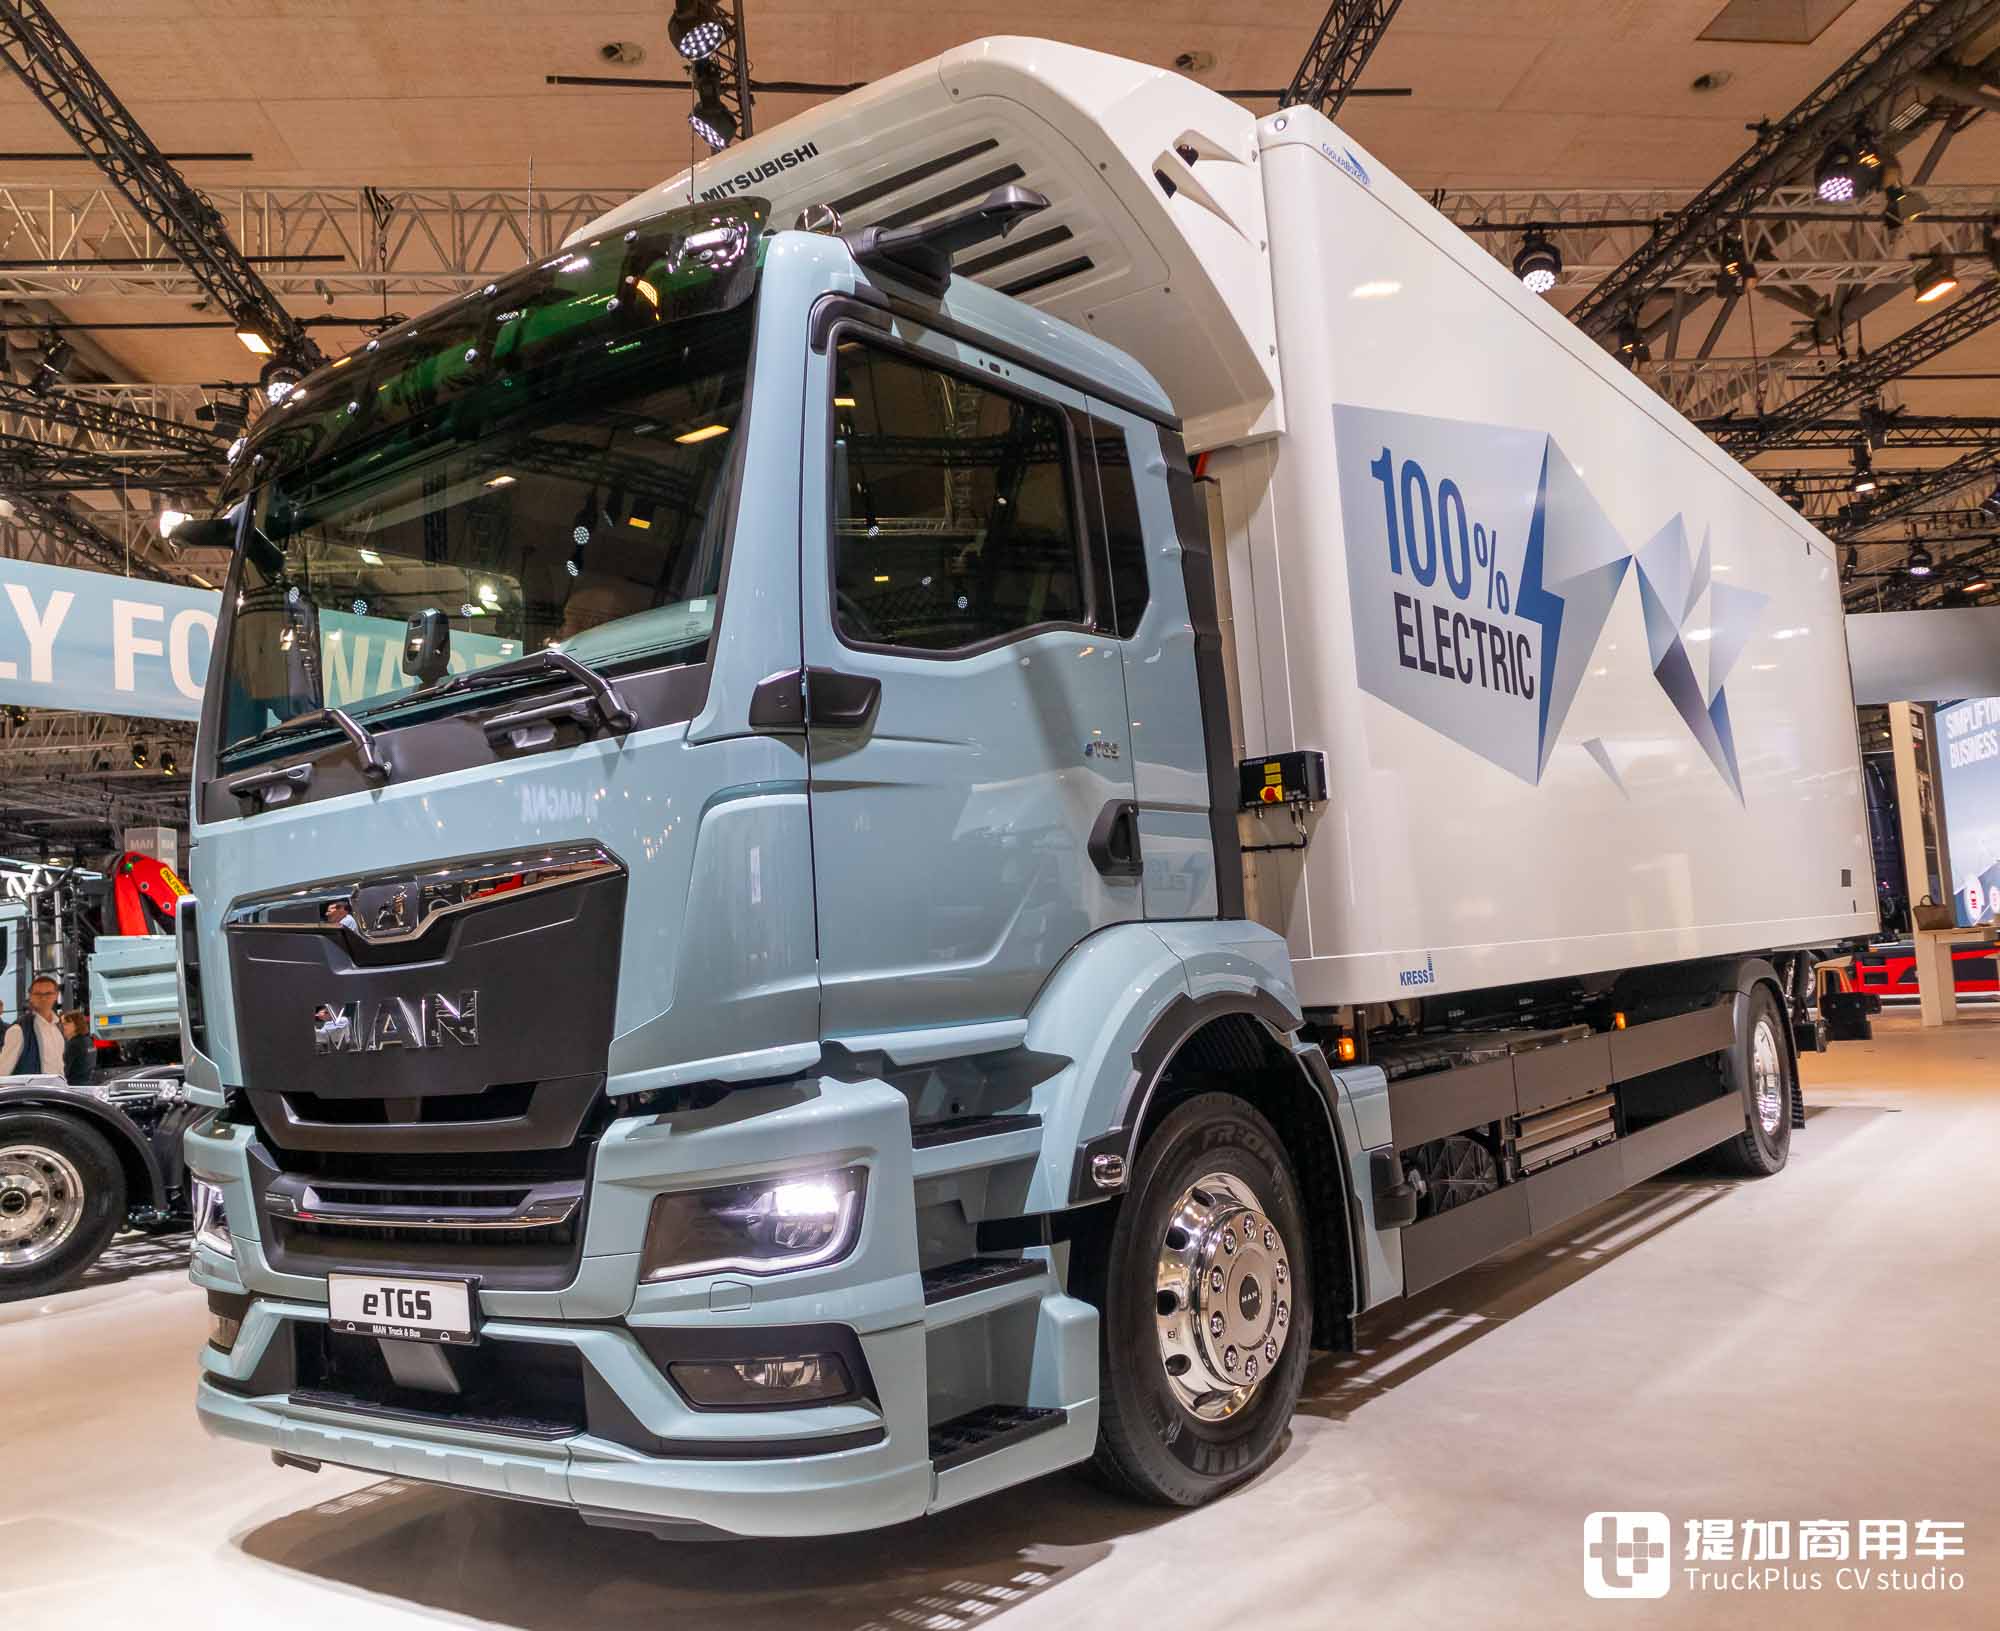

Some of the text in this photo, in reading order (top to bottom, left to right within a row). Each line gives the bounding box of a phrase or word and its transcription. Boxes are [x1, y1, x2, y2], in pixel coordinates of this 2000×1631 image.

[700, 142, 819, 202] MITSUBISHI
[1371, 446, 1510, 615] 100%
[1394, 591, 1535, 700] ELECTRIC
[1948, 729, 1999, 768] BUSINESS
[1400, 969, 1429, 986] KRESS
[314, 989, 481, 1055] MAN
[363, 1287, 432, 1321] eTGS
[1241, 1290, 1258, 1304] MAN
[372, 1324, 387, 1336] MAN
[409, 1328, 421, 1338] Bus
